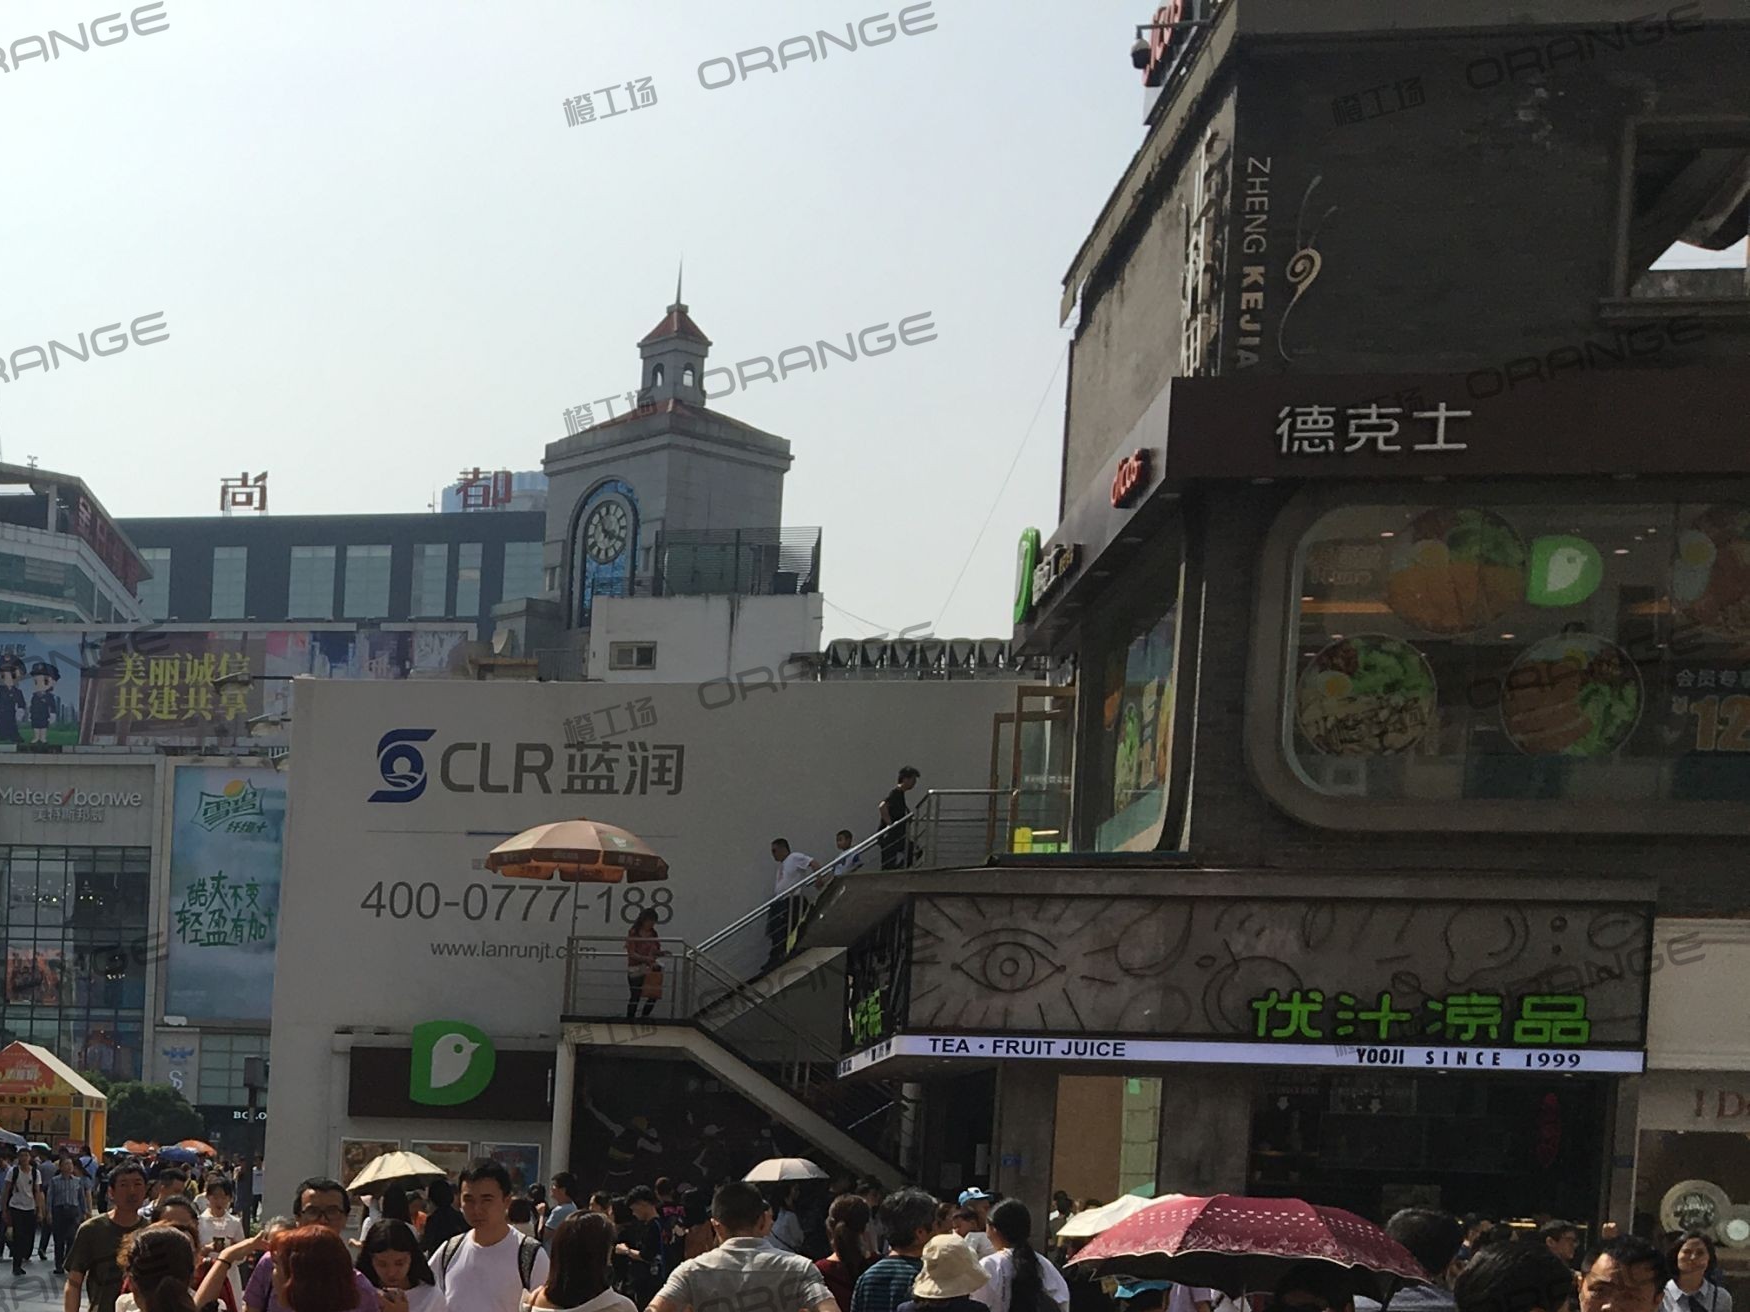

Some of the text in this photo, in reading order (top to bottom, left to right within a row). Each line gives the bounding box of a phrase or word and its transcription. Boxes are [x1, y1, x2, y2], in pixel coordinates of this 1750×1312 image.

[1232, 155, 1271, 371] ZHENG KEJIA
[1276, 403, 1473, 454] 德克士
[114, 651, 250, 688] 美丽诚信
[111, 686, 248, 721] 共建共享
[186, 869, 261, 911] 酷爽不变
[929, 1037, 971, 1054] TEA
[992, 1038, 1056, 1057] FRUIT
[1061, 1040, 1126, 1058] JUICE
[1356, 1047, 1582, 1068] YOOJI SINCE 1999
